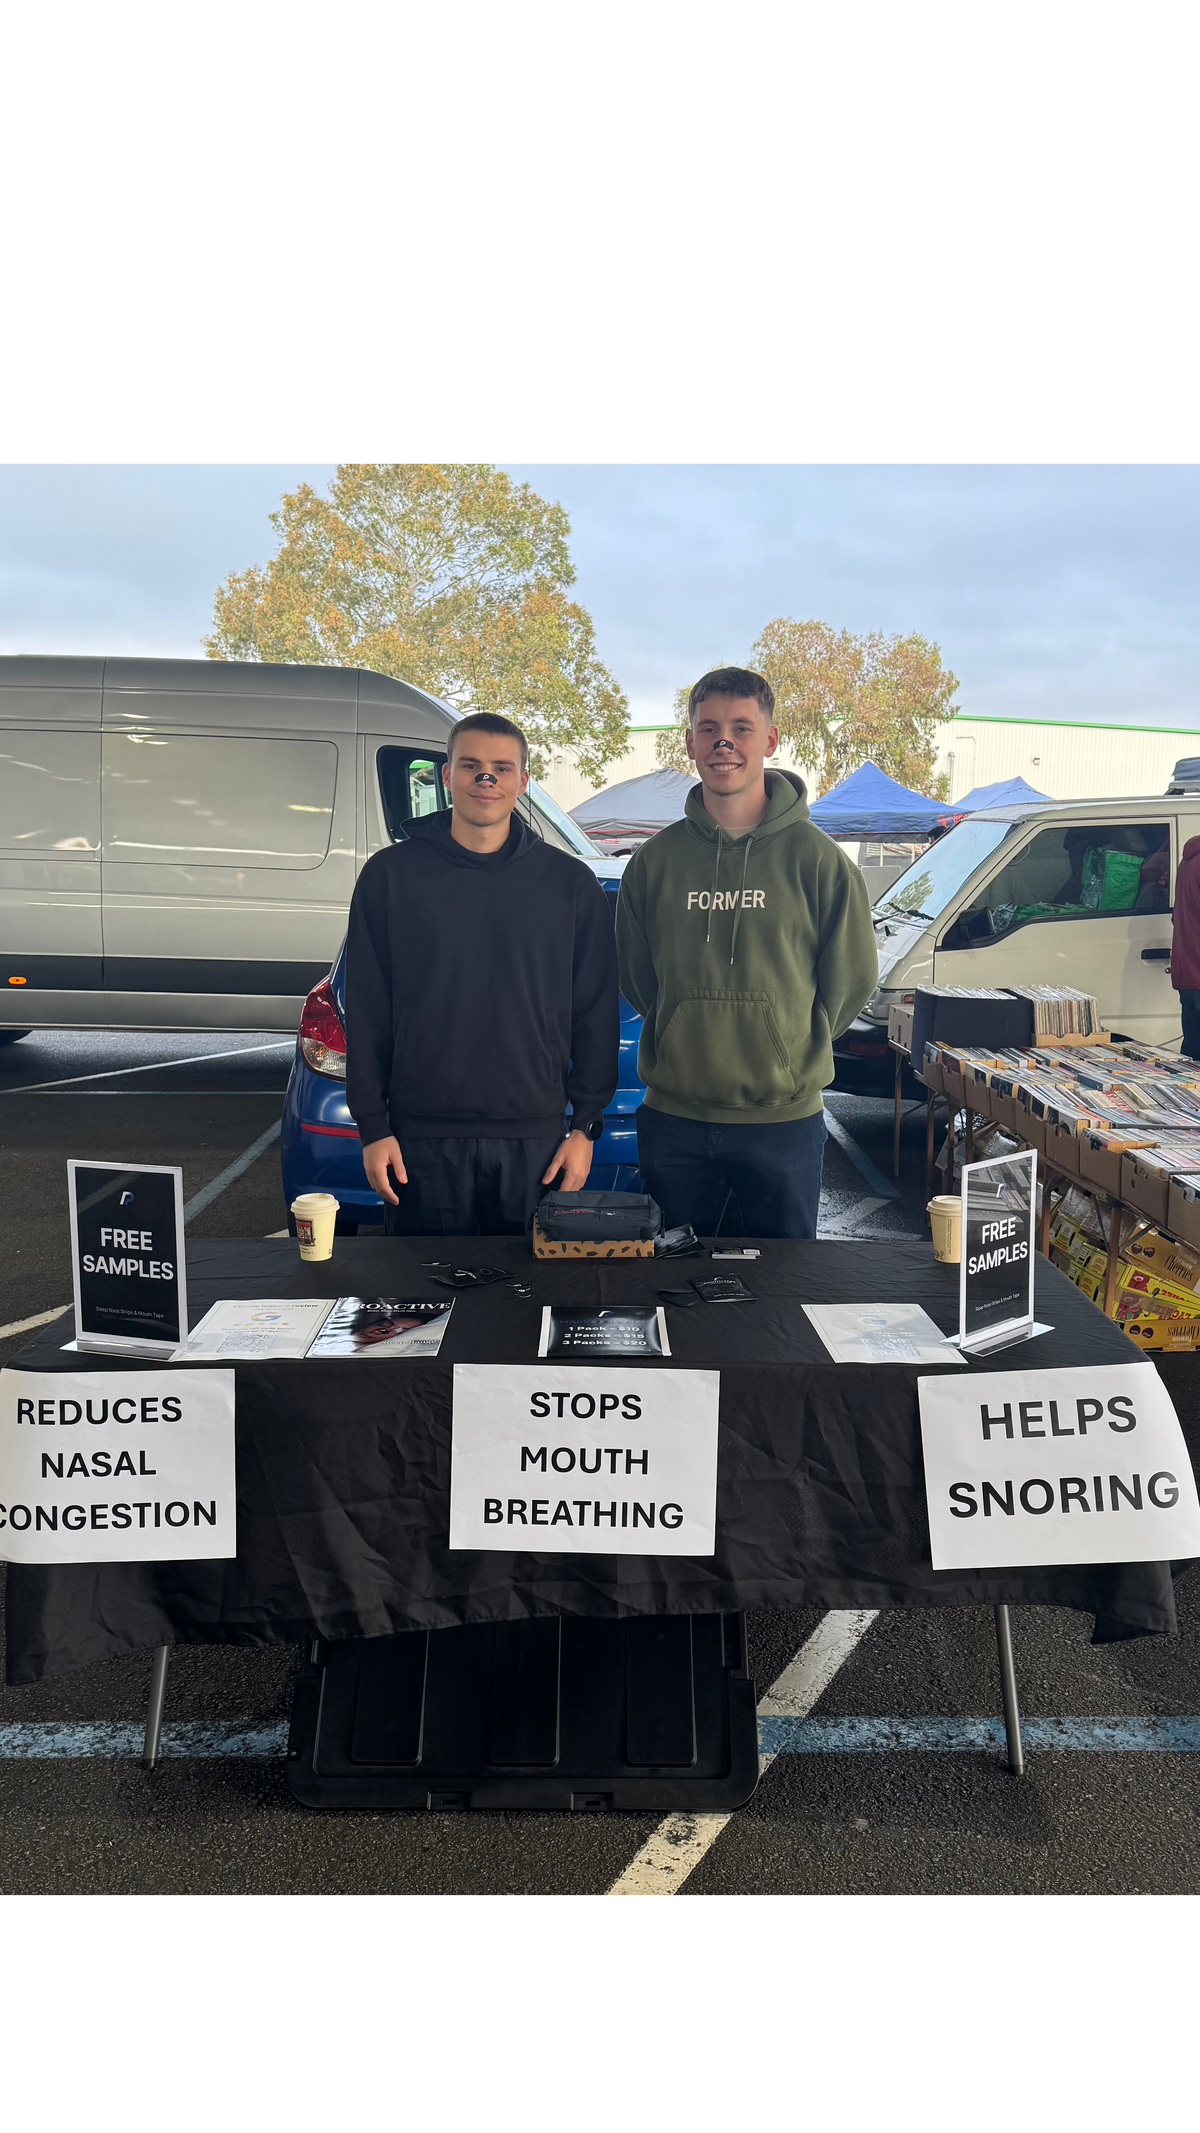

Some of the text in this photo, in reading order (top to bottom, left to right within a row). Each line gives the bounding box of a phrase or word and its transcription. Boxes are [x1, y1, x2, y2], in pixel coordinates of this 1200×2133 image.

[687, 890, 766, 911] FORMER
[100, 1227, 153, 1251] FREE
[982, 1217, 1016, 1245] FREE
[82, 1254, 174, 1281] SAMPLES
[968, 1241, 1028, 1275] SAMPLES
[357, 1302, 451, 1310] ROACTIVE
[17, 1396, 182, 1425] REDUCES
[530, 1391, 642, 1420] STOPS
[980, 1395, 1137, 1440] HELPS
[41, 1450, 156, 1478] NASAL
[520, 1446, 648, 1475] MOUTH
[949, 1471, 1179, 1518] SNORING
[483, 1498, 684, 1529] BREATHING
